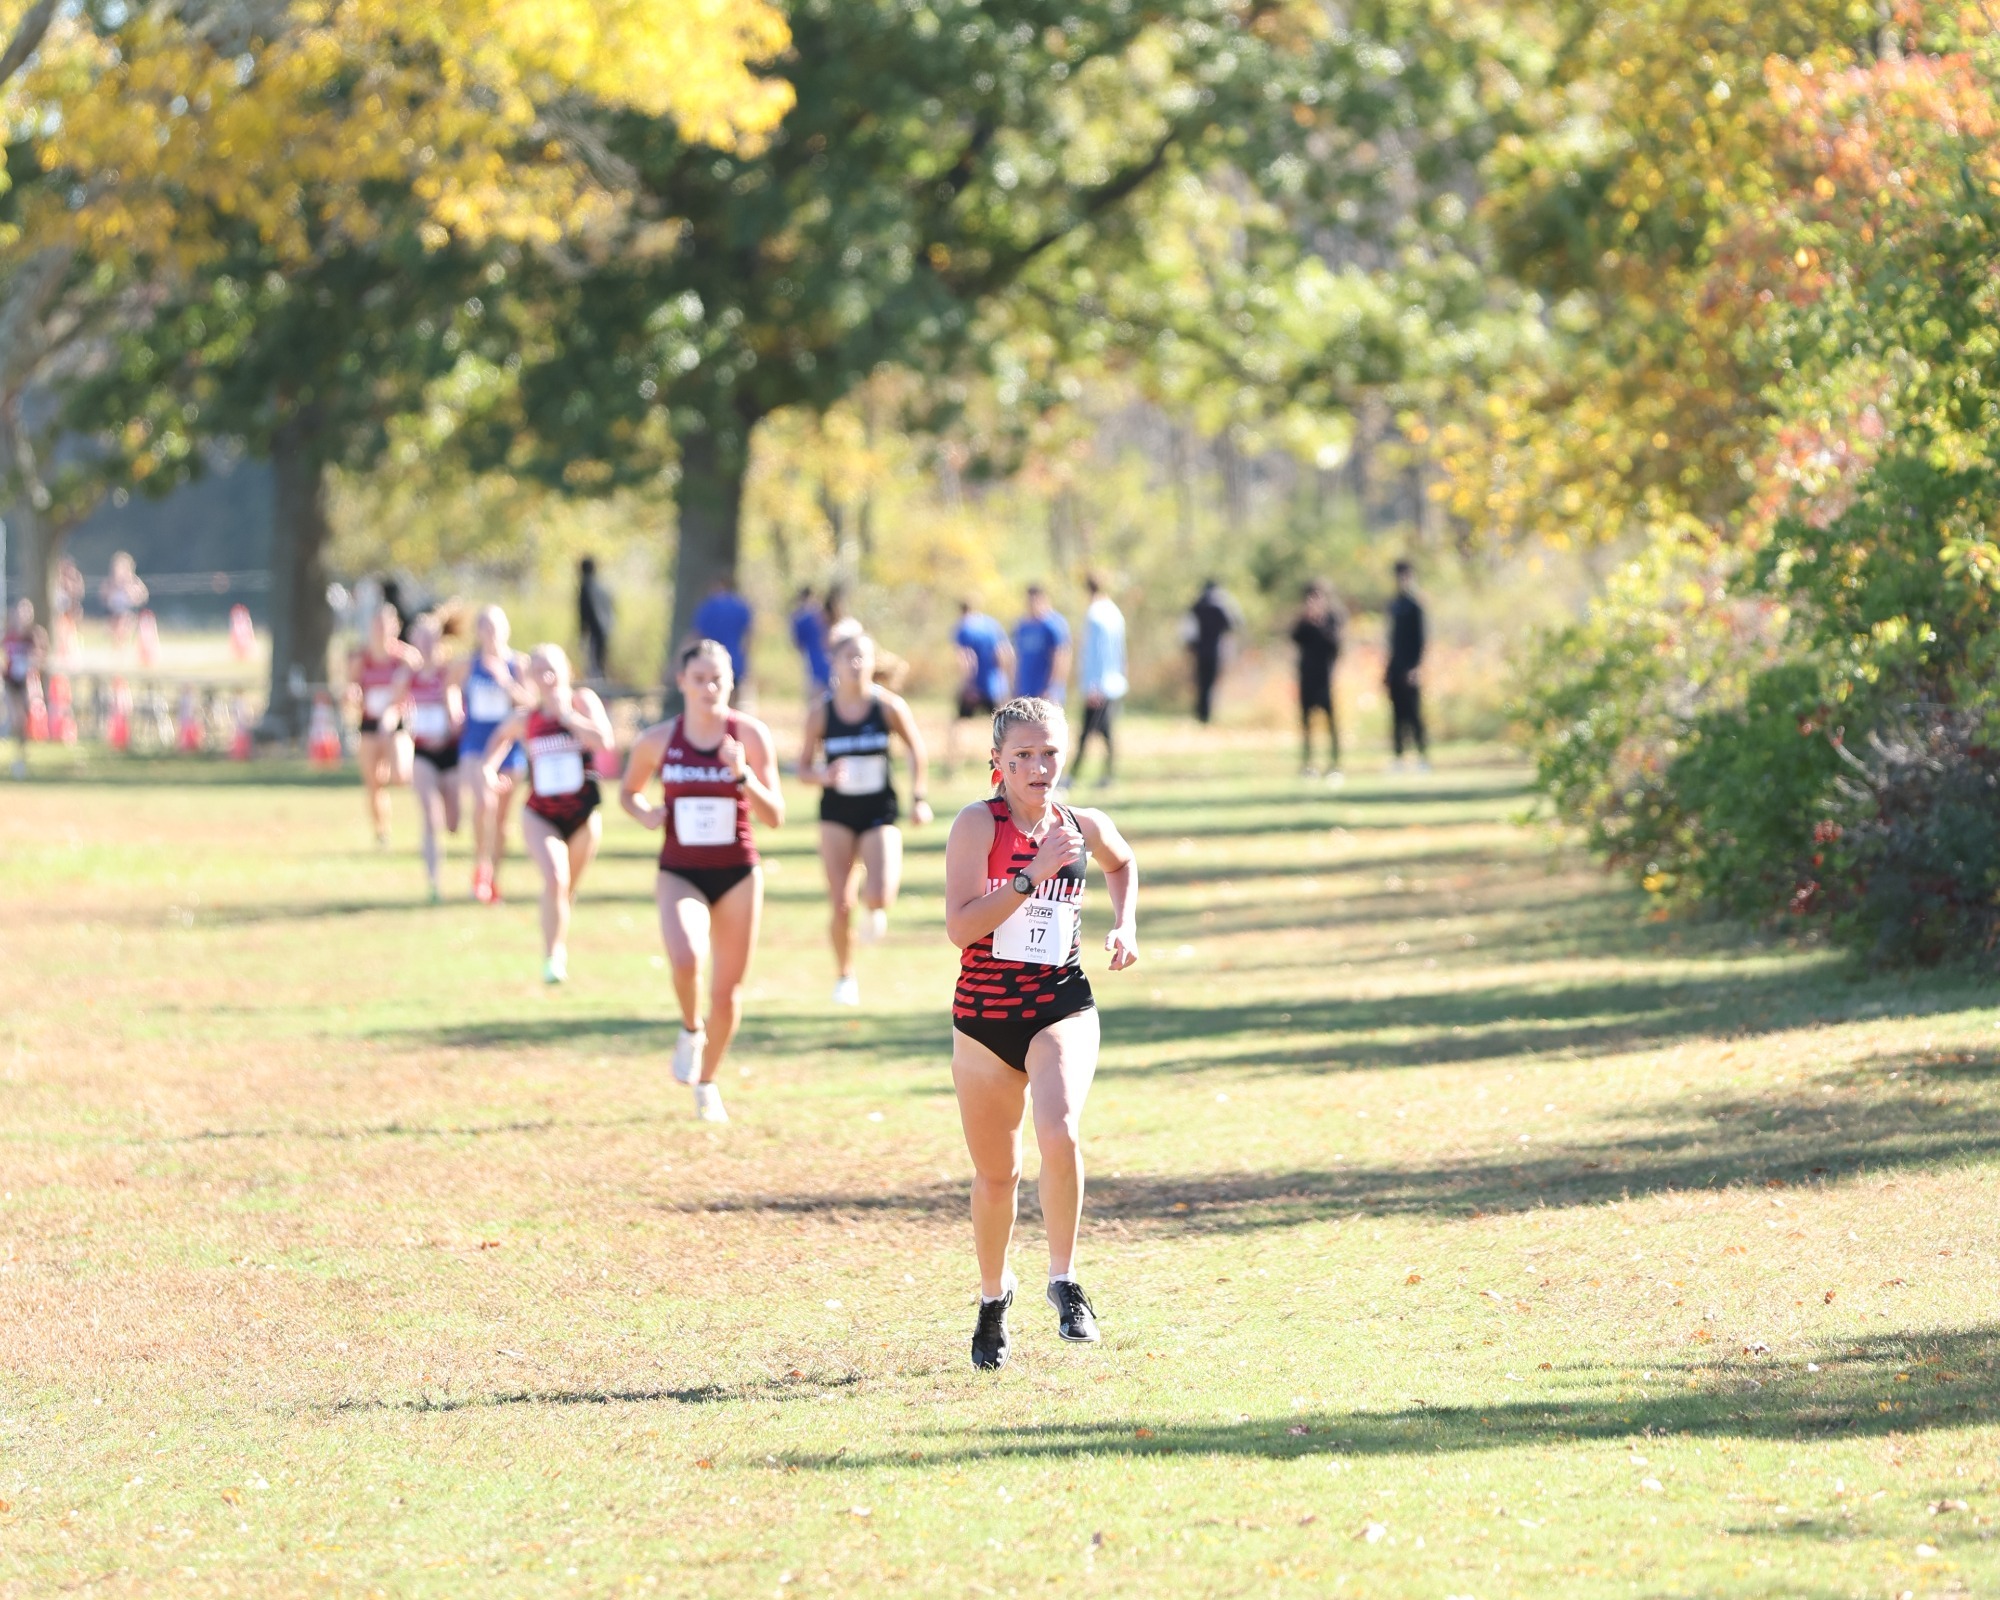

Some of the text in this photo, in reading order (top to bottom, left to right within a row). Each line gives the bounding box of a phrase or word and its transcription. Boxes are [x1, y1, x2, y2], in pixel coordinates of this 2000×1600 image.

[662, 764, 737, 783] MOLLO
[1030, 906, 1053, 918] ECC
[1030, 927, 1046, 944] 17
[1025, 945, 1047, 954] Peters
